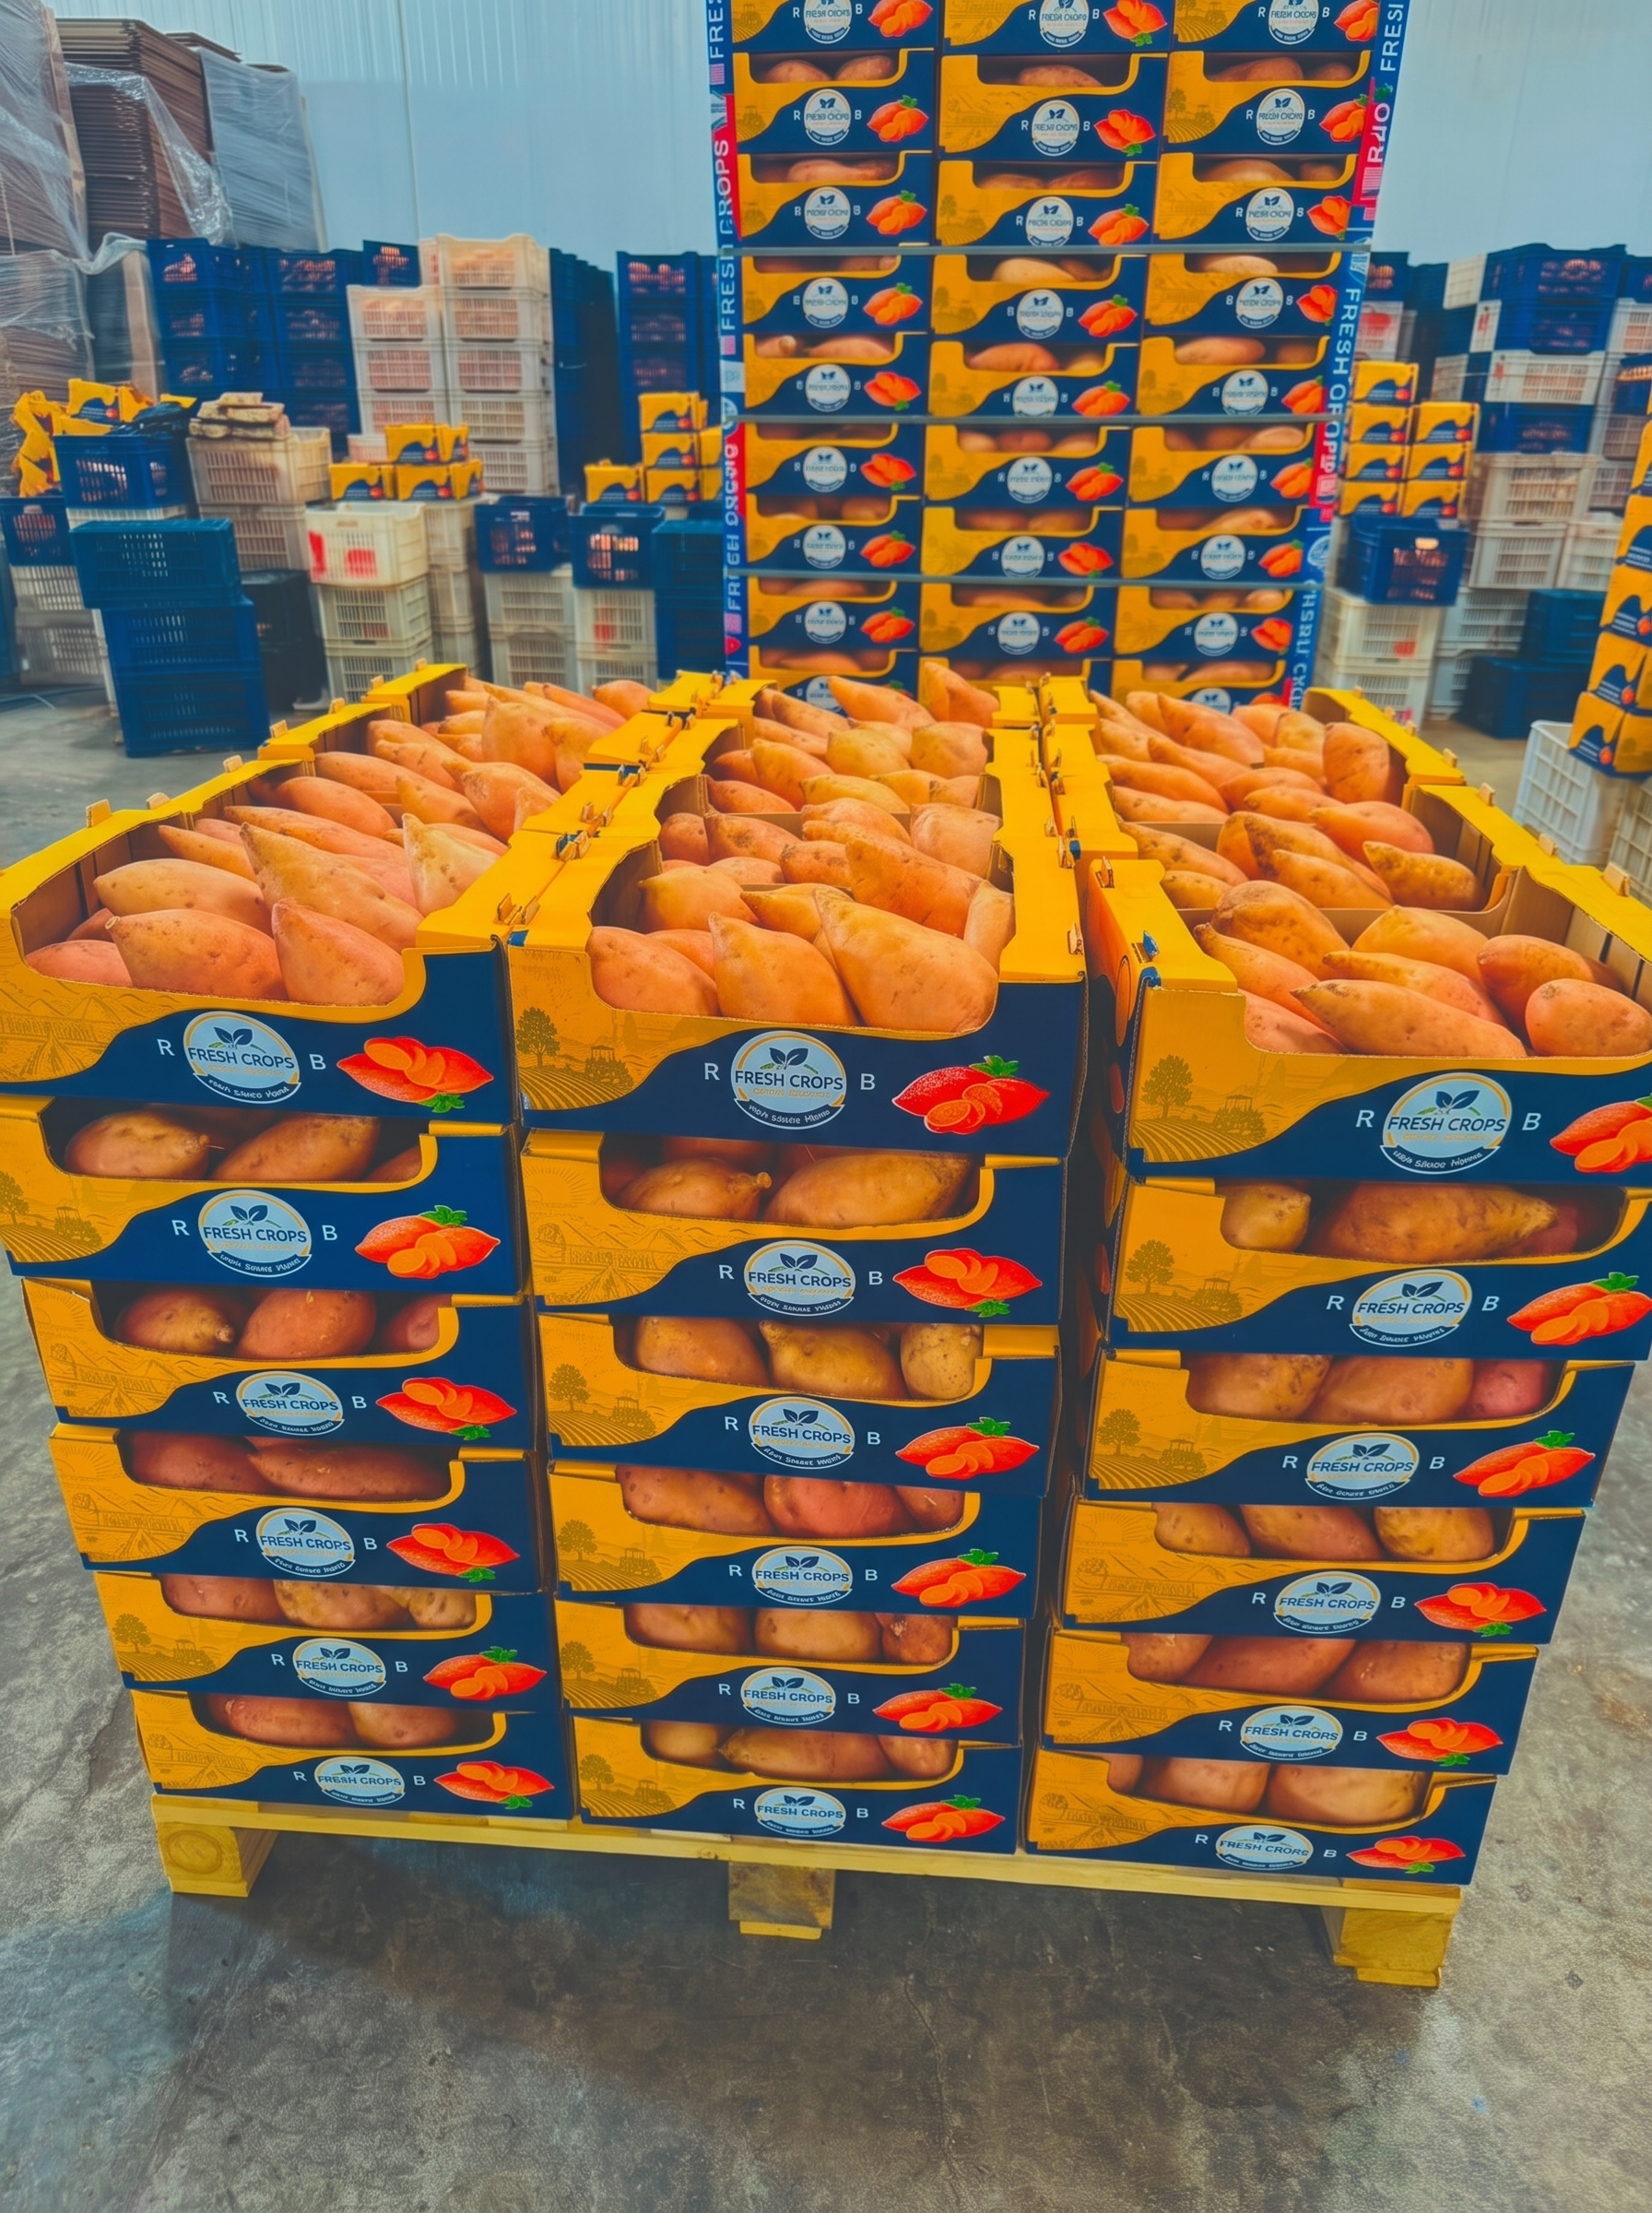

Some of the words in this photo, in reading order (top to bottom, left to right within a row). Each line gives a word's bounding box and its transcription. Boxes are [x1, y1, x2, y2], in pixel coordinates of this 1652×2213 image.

[793, 7, 800, 18] R
[856, 4, 863, 15] B
[1029, 10, 1035, 20] R
[1092, 9, 1100, 18] B
[1258, 7, 1266, 17] R
[1322, 7, 1329, 17] B
[709, 0, 724, 58] FRE
[794, 111, 800, 120] R
[855, 111, 861, 119] B
[1246, 110, 1253, 119] R
[1307, 110, 1315, 119] B
[1021, 121, 1029, 130] R
[1083, 121, 1090, 131] B
[1077, 217, 1083, 226] B
[1333, 289, 1361, 374] FRESH
[157, 1039, 175, 1056] R
[188, 1047, 238, 1064] FRESH
[242, 1054, 295, 1069] CROPS
[309, 1054, 326, 1071] B
[704, 1063, 720, 1081] R
[736, 1071, 785, 1086] FRESH
[790, 1075, 843, 1090] CROPS
[860, 1073, 875, 1091] B
[1356, 1109, 1375, 1128] R
[1387, 1117, 1446, 1130] FRESH
[1448, 1118, 1506, 1131] CROPS
[1522, 1113, 1541, 1130] B
[171, 1220, 190, 1236] R
[322, 1225, 337, 1240] B
[203, 1227, 253, 1240] FRESH
[256, 1230, 307, 1242] CROPS
[719, 1265, 735, 1279] R
[749, 1272, 796, 1284] FRESH
[800, 1275, 851, 1287] CROPS
[868, 1272, 883, 1285] B
[1326, 1296, 1344, 1310] R
[1357, 1303, 1410, 1314] FRESH
[1411, 1303, 1465, 1314] CROPS
[1481, 1296, 1500, 1311] B
[213, 1391, 230, 1404] R
[352, 1396, 367, 1409] B
[242, 1399, 287, 1409] FRESH
[290, 1401, 338, 1410] CROPS
[725, 1416, 738, 1430] R
[752, 1426, 797, 1438] FRESH
[802, 1430, 851, 1443] CROPS
[867, 1432, 880, 1444] B
[1282, 1456, 1298, 1468] R
[1311, 1462, 1362, 1472] FRESH
[1363, 1462, 1414, 1472] CROPS
[1429, 1457, 1446, 1470] B
[234, 1529, 249, 1543] R
[260, 1536, 302, 1547] FRESH
[363, 1538, 377, 1550] B
[728, 1565, 742, 1577] R
[756, 1570, 799, 1580] FRESH
[803, 1572, 849, 1581] CROPS
[866, 1569, 878, 1580] B
[1252, 1592, 1266, 1604] R
[1279, 1598, 1326, 1607] FRESH
[1328, 1600, 1375, 1609] CROPS
[1391, 1597, 1406, 1608] B
[271, 1654, 285, 1666] R
[296, 1661, 336, 1671] FRESH
[340, 1663, 384, 1673] CROPS
[395, 1662, 408, 1673] B
[718, 1684, 731, 1696] R
[744, 1690, 785, 1700] FRESH
[789, 1693, 832, 1703] CROPS
[848, 1694, 860, 1704] B
[1219, 1721, 1233, 1732] R
[1245, 1727, 1291, 1736] FRESH
[1353, 1731, 1367, 1741] B
[293, 1771, 306, 1781] R
[317, 1776, 357, 1784] FRESH
[413, 1776, 426, 1785] B
[733, 1799, 745, 1809] R
[758, 1805, 797, 1815] FRESH
[801, 1809, 843, 1818] CROPS
[856, 1808, 868, 1817] B
[1195, 1834, 1209, 1843] R
[1220, 1840, 1263, 1851] FRESH
[1324, 1850, 1337, 1858] B
